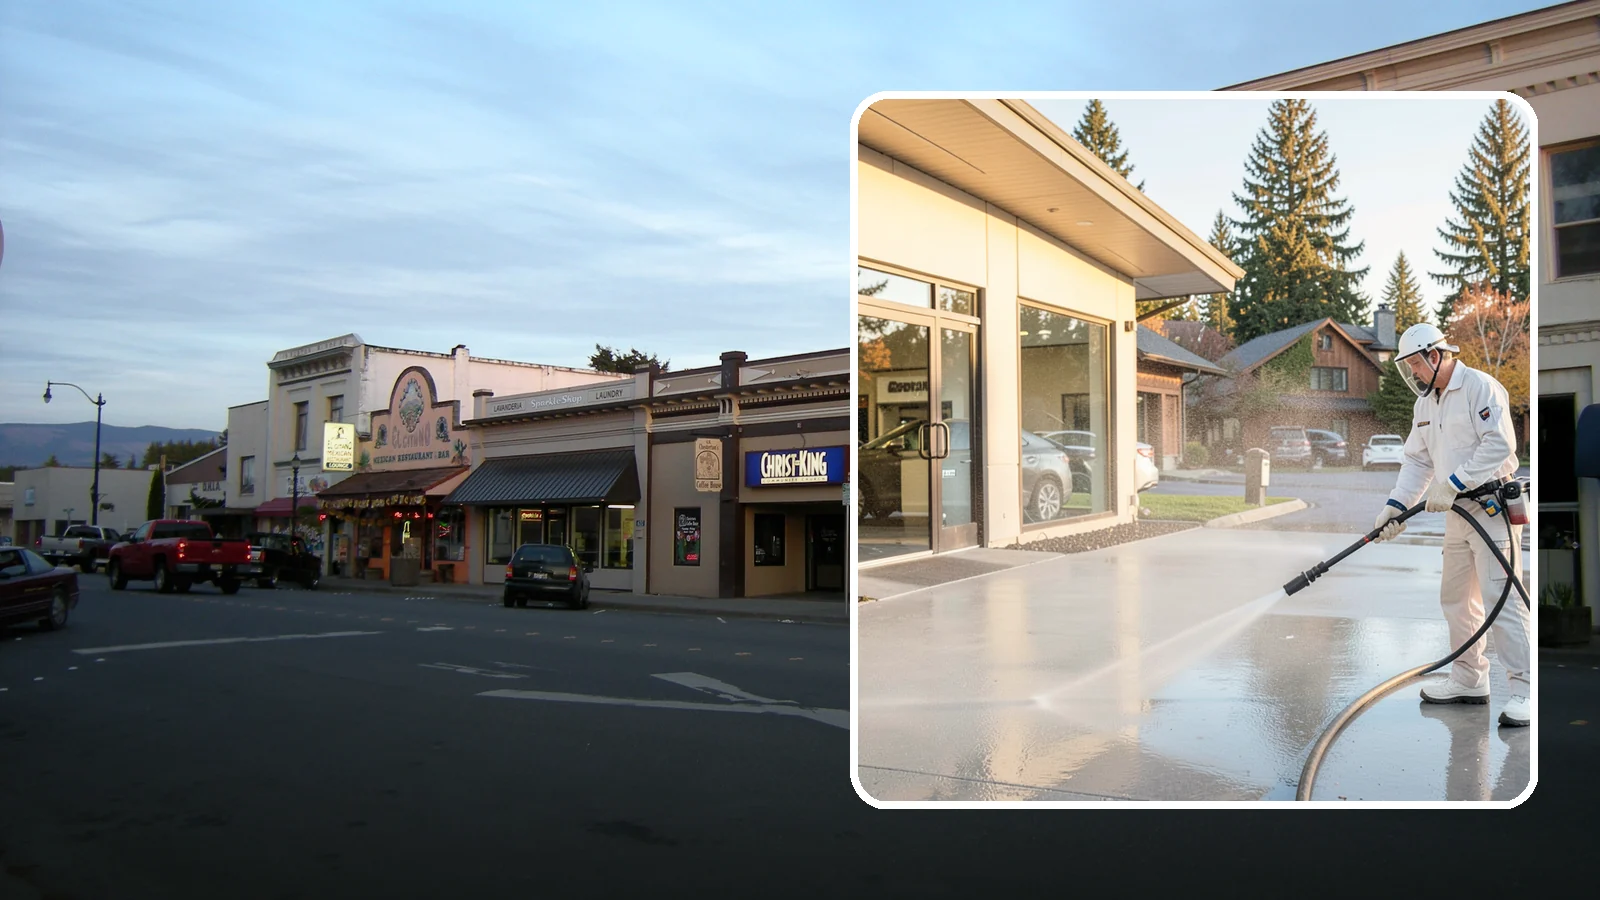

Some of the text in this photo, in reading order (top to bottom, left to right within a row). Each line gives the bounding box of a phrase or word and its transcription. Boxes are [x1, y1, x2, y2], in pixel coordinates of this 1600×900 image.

[561, 394, 582, 405] Shop
[595, 389, 623, 399] LAUNDRY
[493, 402, 523, 412] LAVANDERIA
[373, 455, 396, 464] MEXICAN
[397, 451, 433, 462] RESTAURANT
[438, 450, 450, 459] BAR
[761, 450, 827, 478] CHRIST KING
